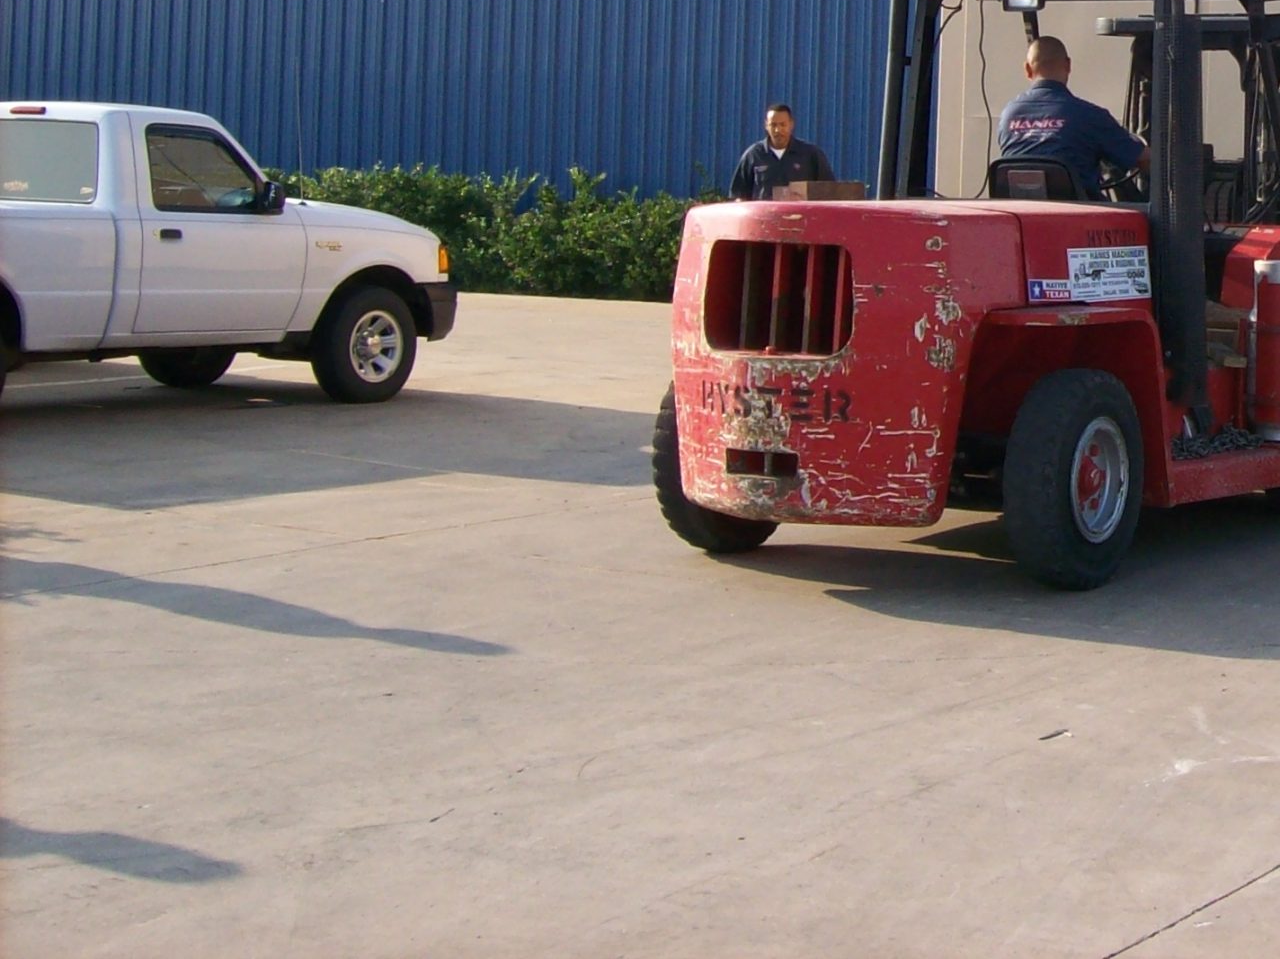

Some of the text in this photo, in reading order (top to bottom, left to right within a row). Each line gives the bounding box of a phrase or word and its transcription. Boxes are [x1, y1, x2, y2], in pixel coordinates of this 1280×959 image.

[1008, 119, 1065, 129] HANKS
[1045, 291, 1070, 299] TEXAN
[702, 379, 852, 422] HYSTER
